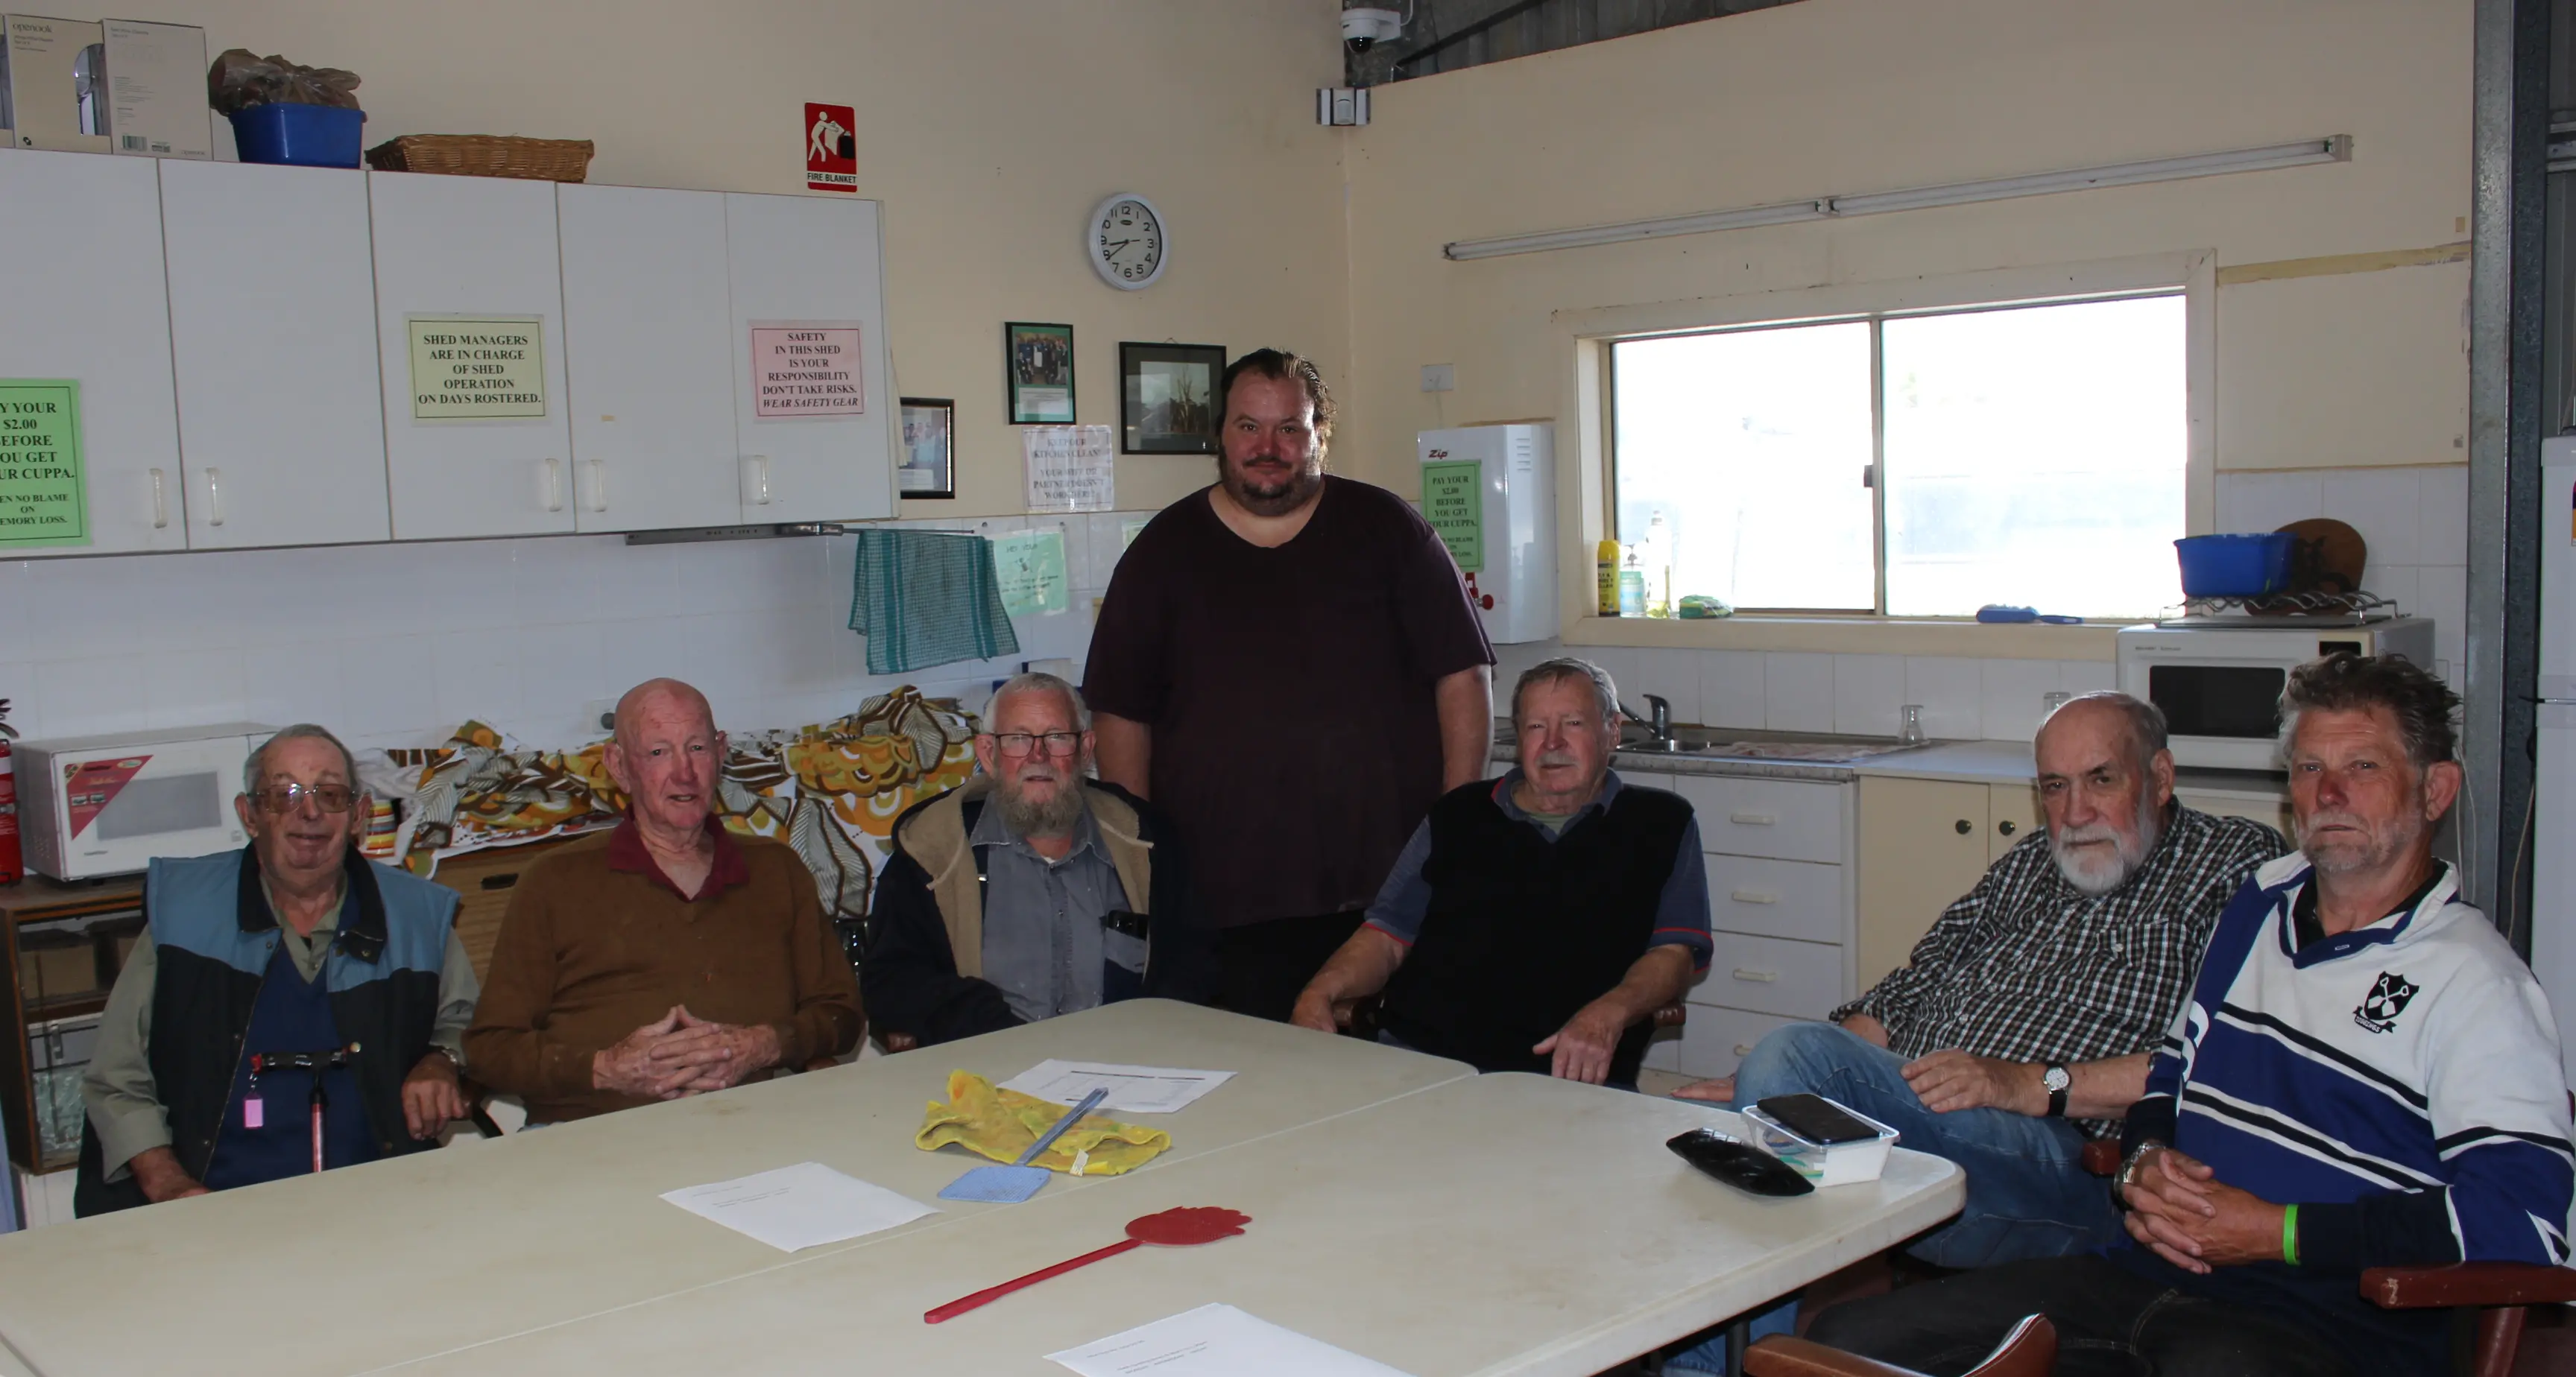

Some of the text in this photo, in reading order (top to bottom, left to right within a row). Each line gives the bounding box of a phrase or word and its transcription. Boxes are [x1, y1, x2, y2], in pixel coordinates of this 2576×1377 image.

[13, 23, 53, 34] openook
[807, 172, 856, 183] FIRE BLANKET
[1121, 206, 1131, 215] 12
[1143, 222, 1151, 232] 2
[1147, 238, 1154, 249] 3
[1144, 253, 1152, 262] 4
[1112, 262, 1120, 273] 7
[1136, 264, 1143, 274] 5
[1124, 268, 1132, 278] 6
[423, 335, 528, 345] SHED MANAGERS
[787, 332, 827, 341] SAFETY
[429, 349, 525, 360] ARE IN CHARGE
[775, 345, 841, 355] IN THIS SHED
[789, 358, 830, 367] IS YOUR
[452, 364, 504, 374] OF SHED
[768, 371, 850, 381] RESPONSIBILITY
[443, 379, 515, 389] OPERATION
[763, 384, 857, 395] DON'T TAKE RISKS.
[418, 393, 541, 404] ON DAYS ROSTERED.
[763, 397, 859, 408] WEAR SAFETY GEAR
[13, 402, 57, 414] YOUR
[3, 419, 37, 430] $2.00
[0, 435, 53, 446] EFORE
[0, 452, 57, 463] OU GET
[1428, 449, 1448, 460] Zip
[22, 468, 75, 479] CUPPA.
[1433, 475, 1469, 485] PAY YOUR
[16, 494, 31, 503] NO
[33, 493, 69, 502] BLAME
[1436, 498, 1466, 506] BEFORE
[1434, 508, 1468, 517] YOU GET
[0, 516, 68, 526] EMORY LOSS.
